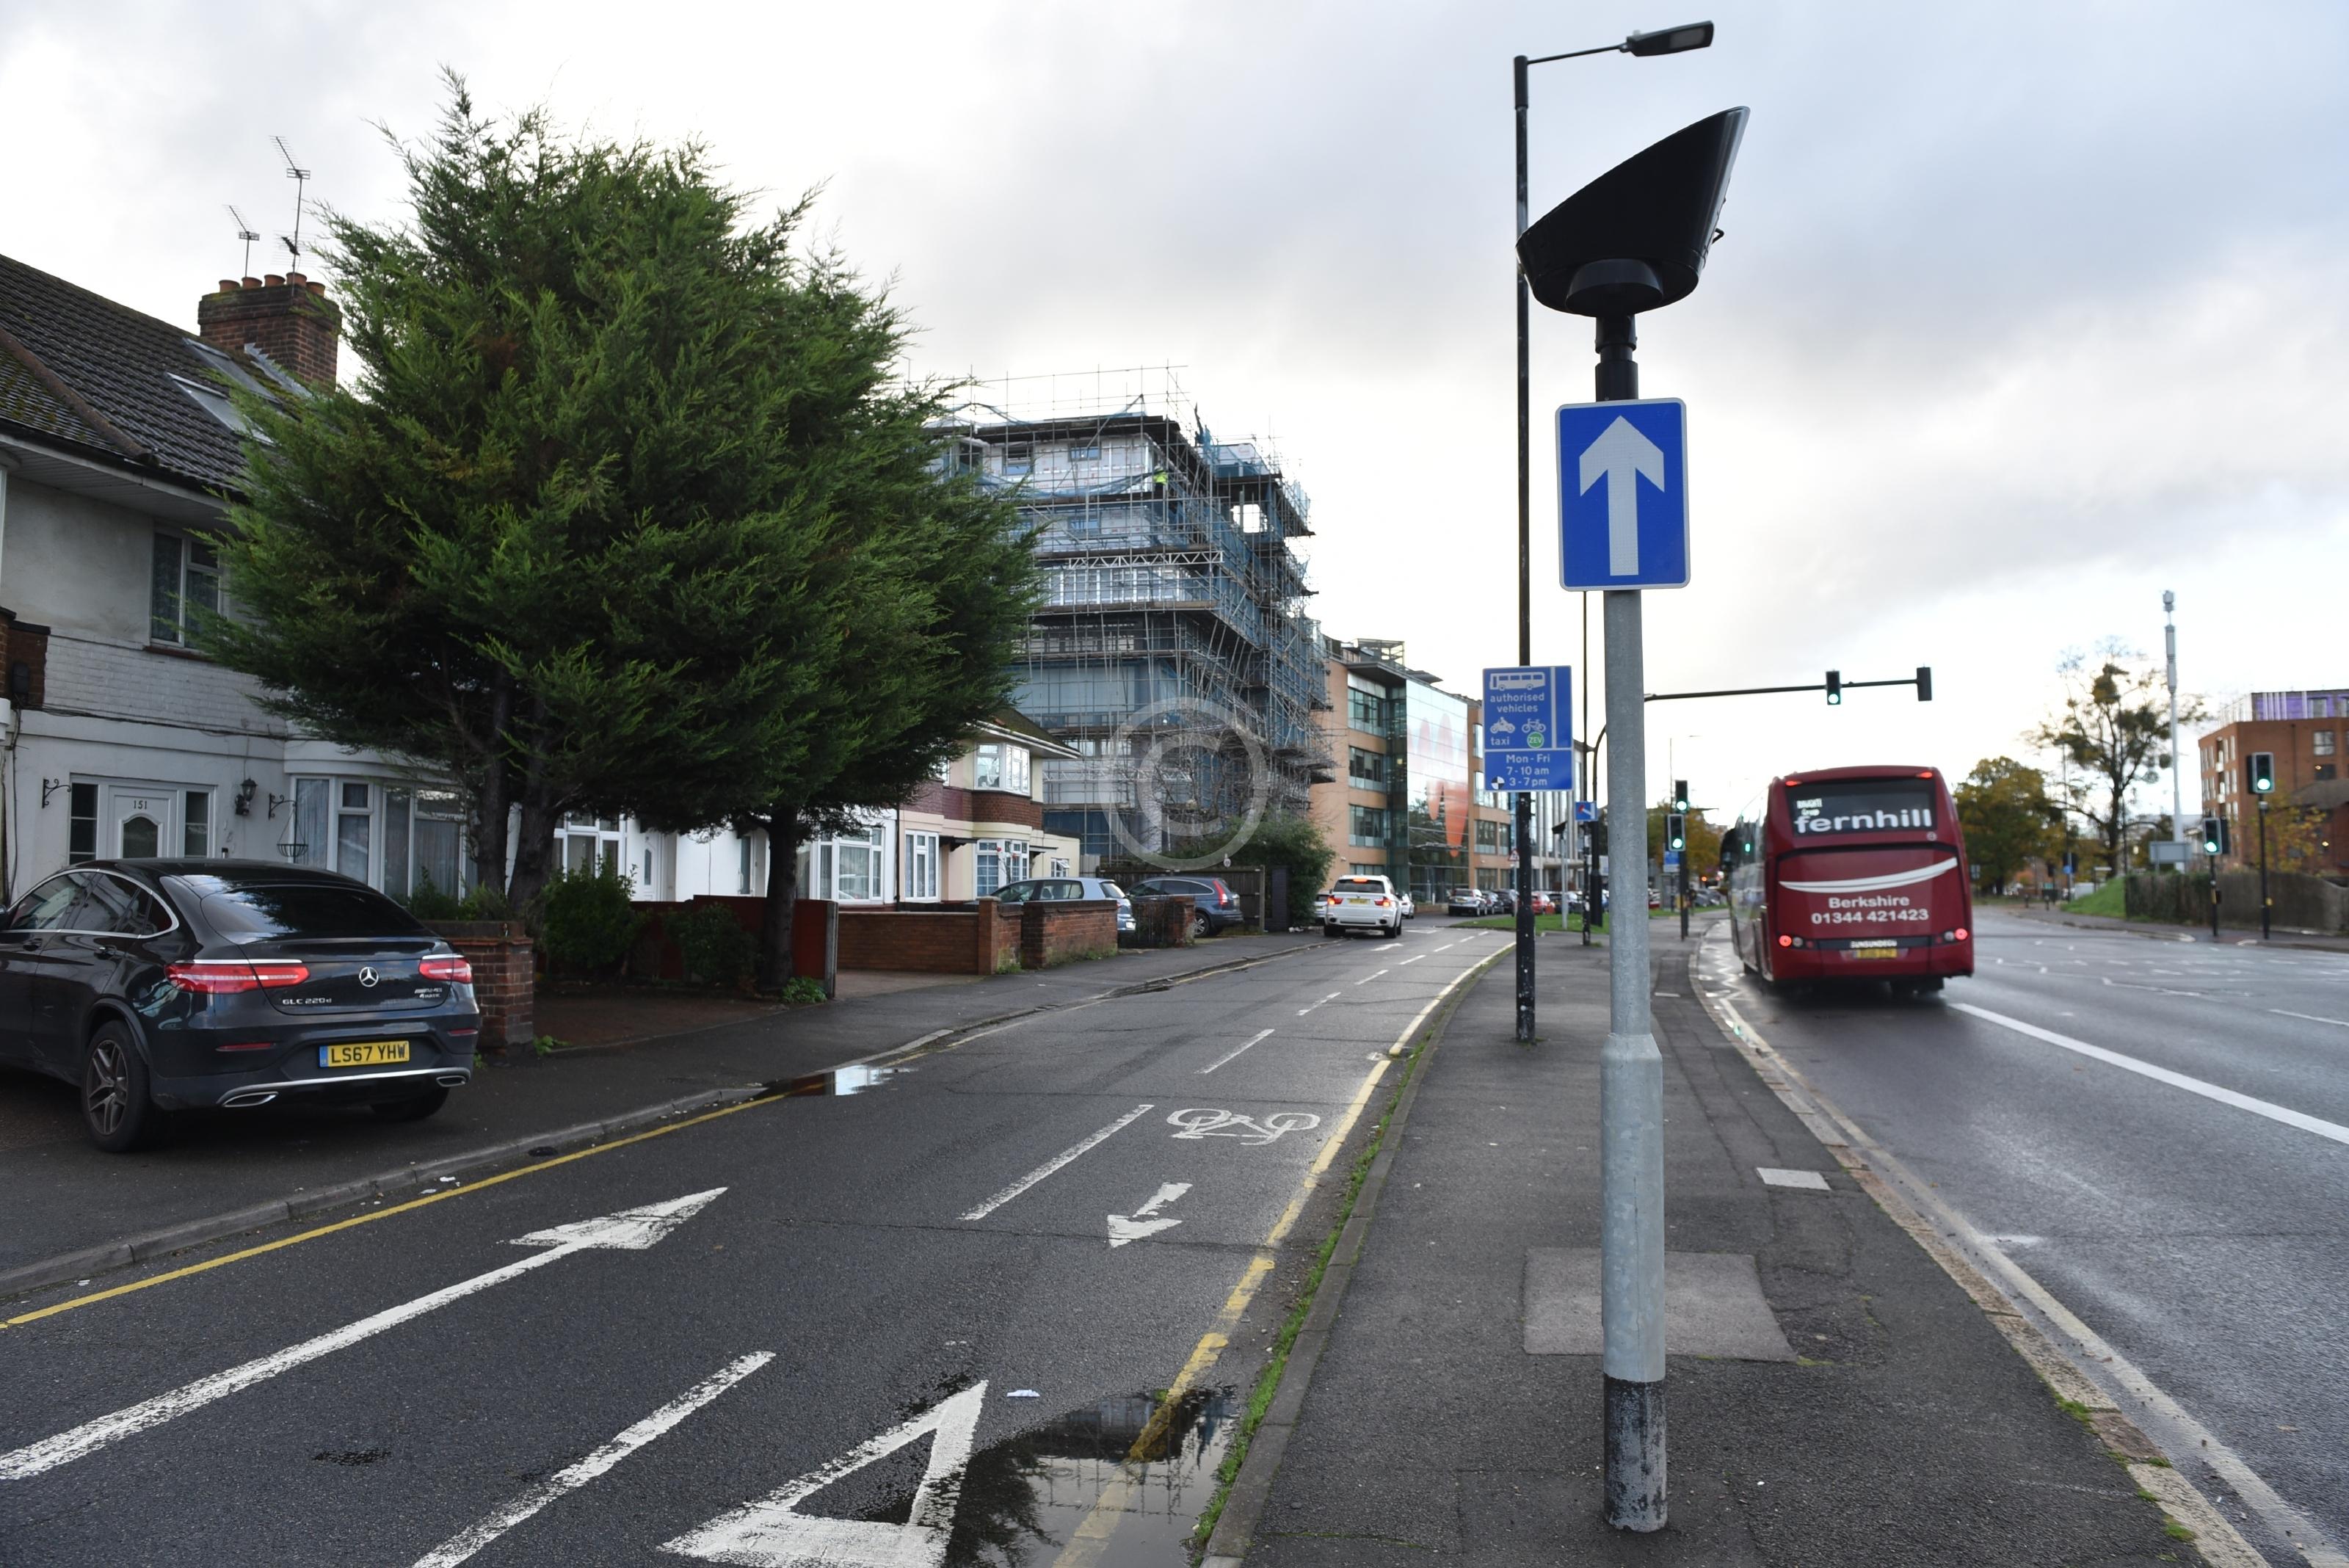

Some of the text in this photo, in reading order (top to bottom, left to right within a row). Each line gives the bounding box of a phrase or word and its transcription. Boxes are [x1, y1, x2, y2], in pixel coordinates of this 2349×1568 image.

[1490, 693, 1544, 703] authorised
[1497, 704, 1538, 713] vehicles
[1490, 736, 1510, 746] taxi
[1506, 755, 1528, 763] Mon
[1536, 754, 1550, 763] Fri
[134, 800, 148, 810] 151
[1794, 808, 1932, 833] fernhill
[1829, 896, 1910, 909] Berkshire
[1811, 909, 1929, 924] 01344 421423
[331, 1044, 406, 1064] LS67 YHW
